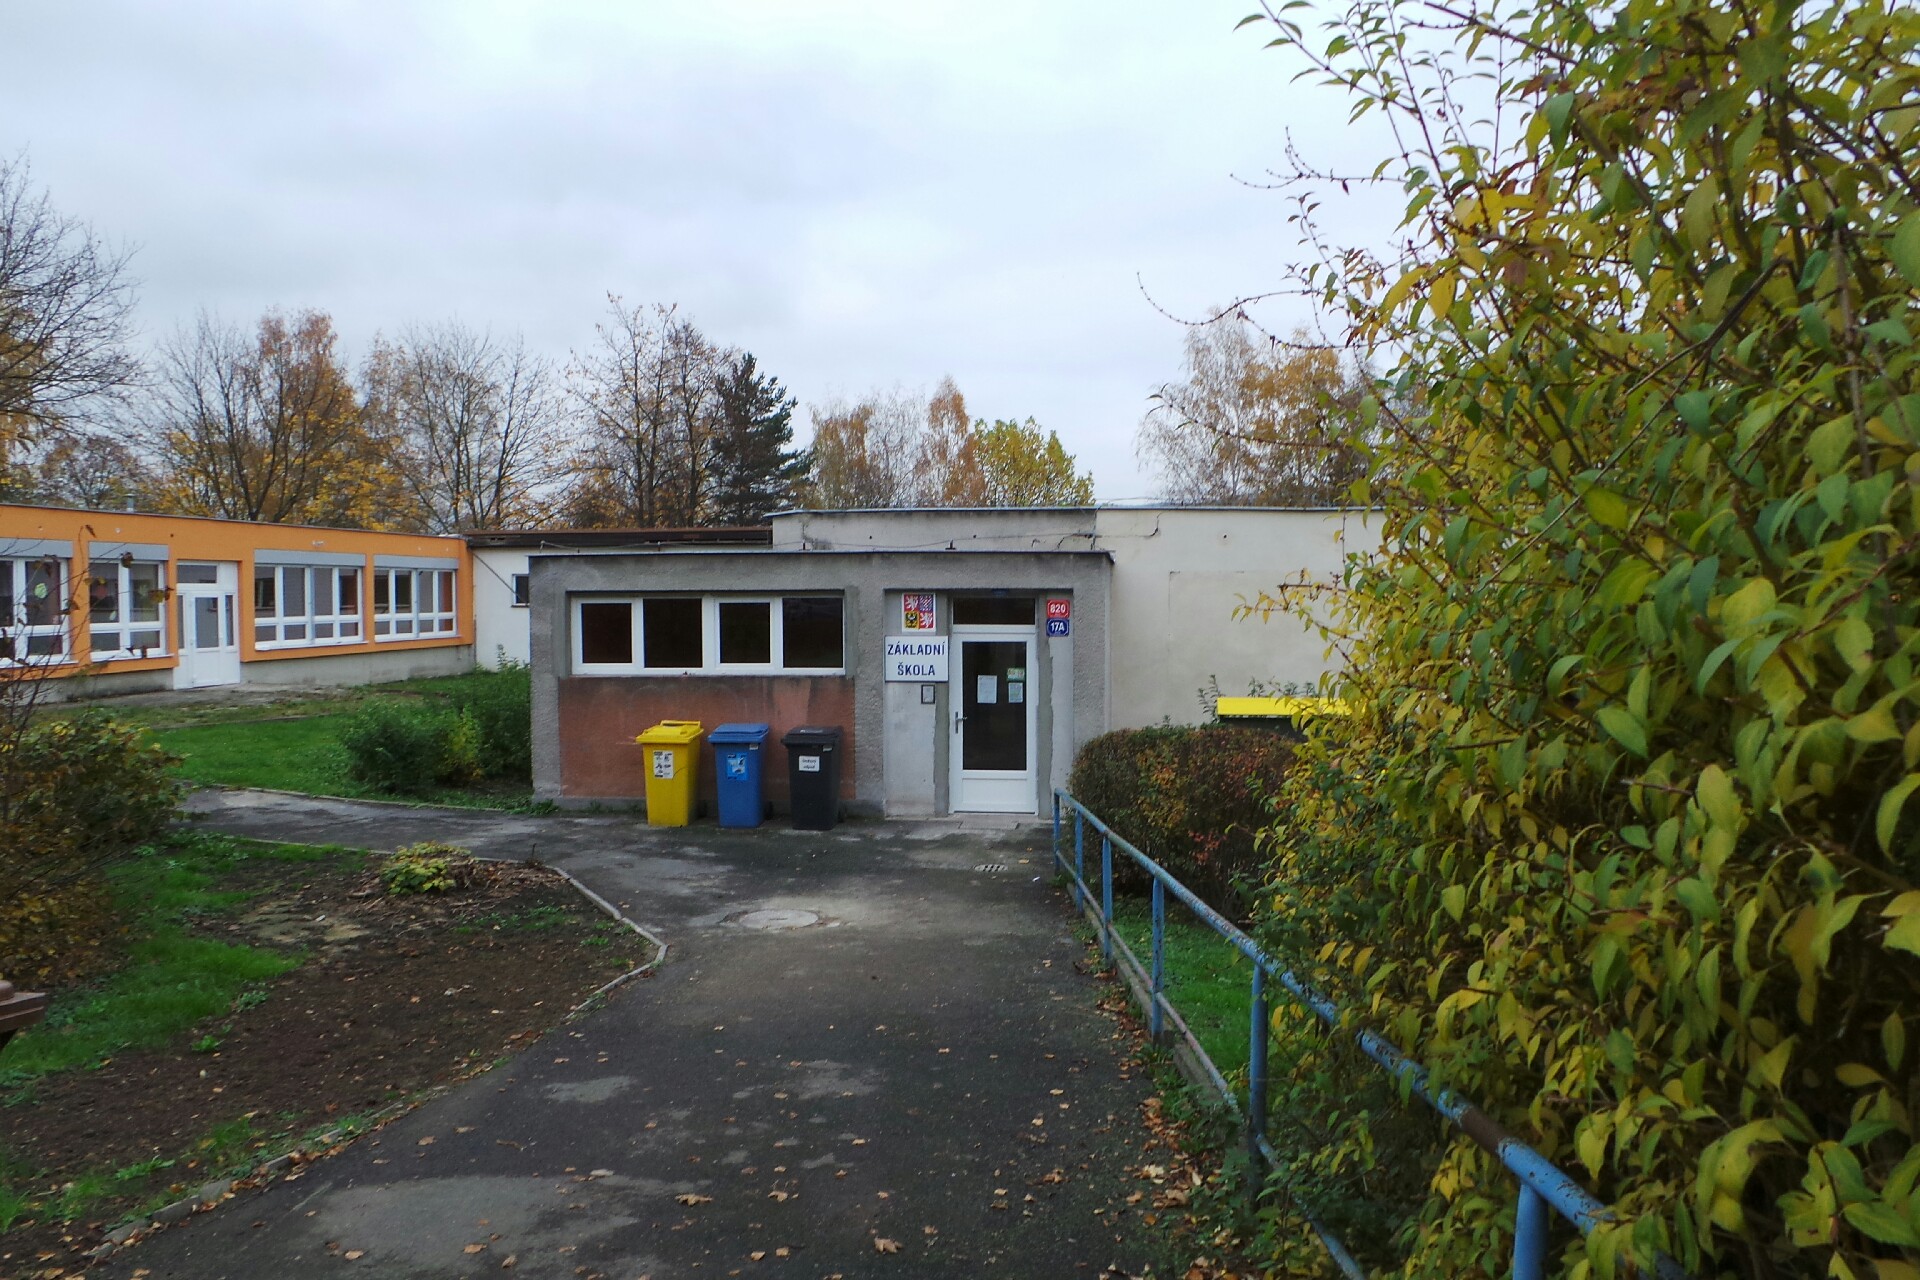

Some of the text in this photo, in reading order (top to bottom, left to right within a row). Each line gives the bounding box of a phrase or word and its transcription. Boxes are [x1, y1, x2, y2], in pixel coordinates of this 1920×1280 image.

[1050, 603, 1066, 614] 820
[1050, 622, 1065, 632] 17A
[888, 641, 945, 656] ZÁKLADNÍ
[898, 662, 935, 676] ŠKOLA
